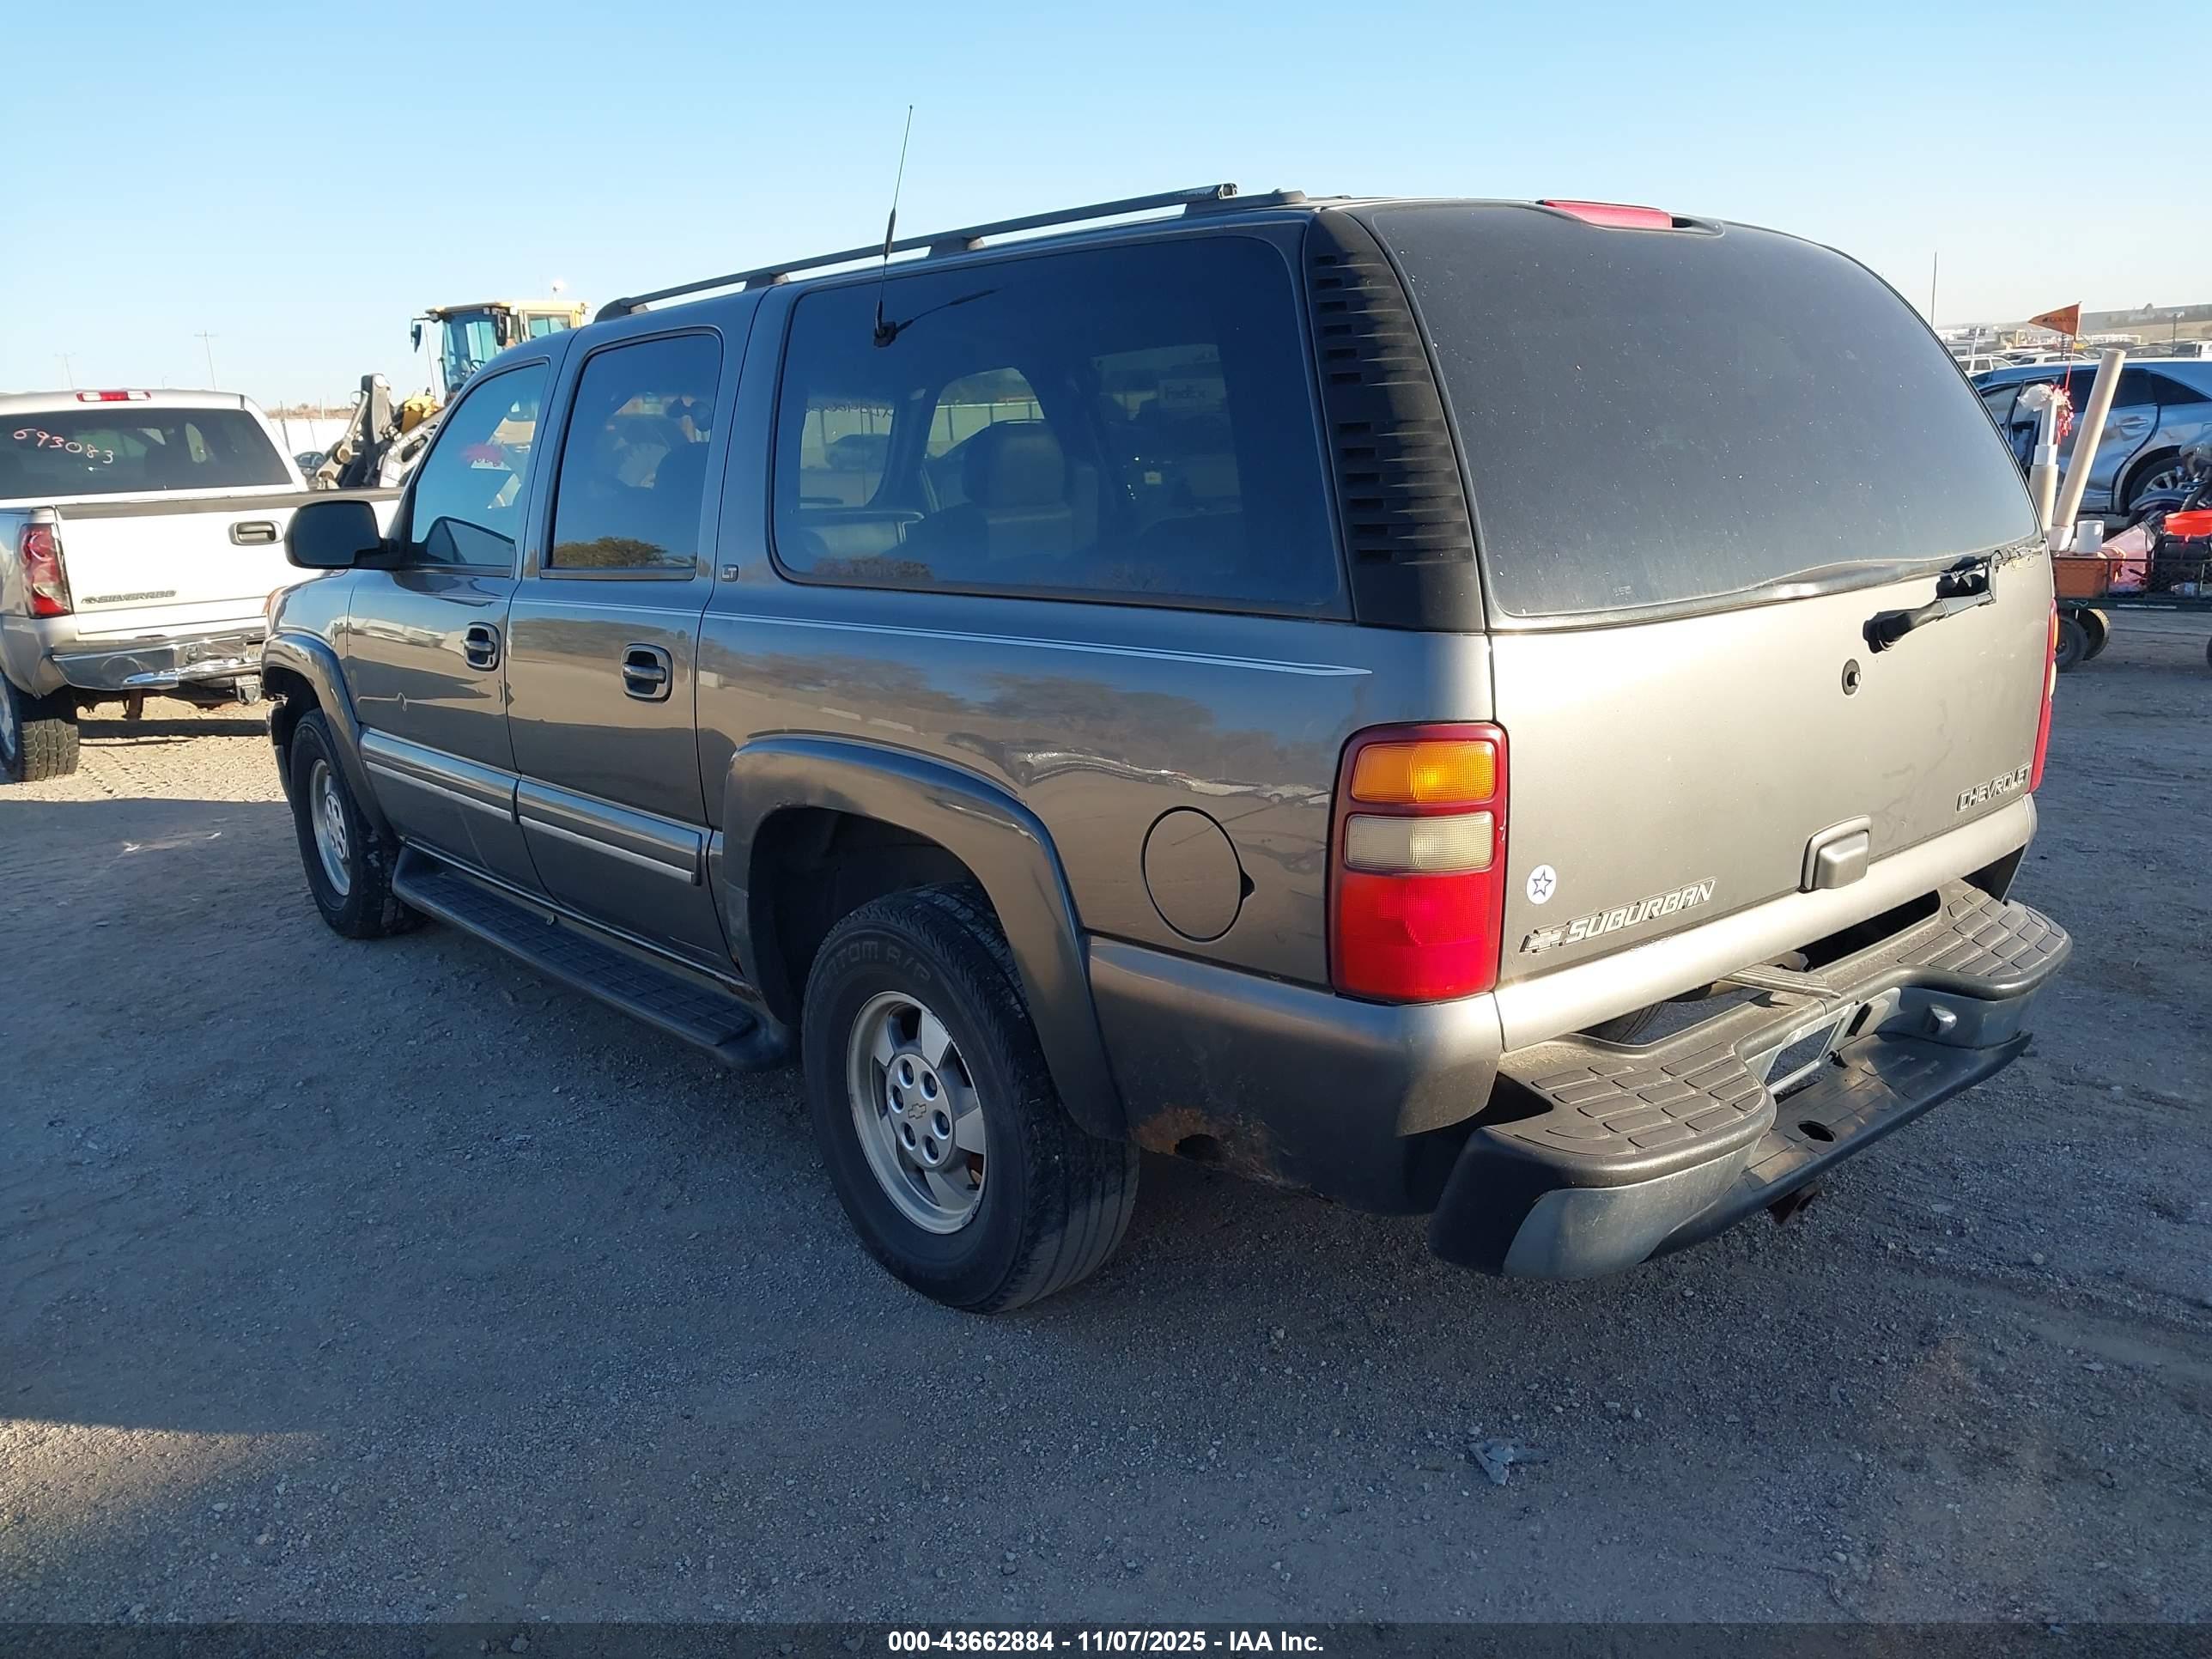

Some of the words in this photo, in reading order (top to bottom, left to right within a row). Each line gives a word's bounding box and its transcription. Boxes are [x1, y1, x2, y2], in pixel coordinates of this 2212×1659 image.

[13, 428, 114, 464] 693083
[721, 567, 738, 579] LT
[1955, 762, 2032, 812] CHEVROLET
[1565, 878, 1717, 945] SUBURBAN
